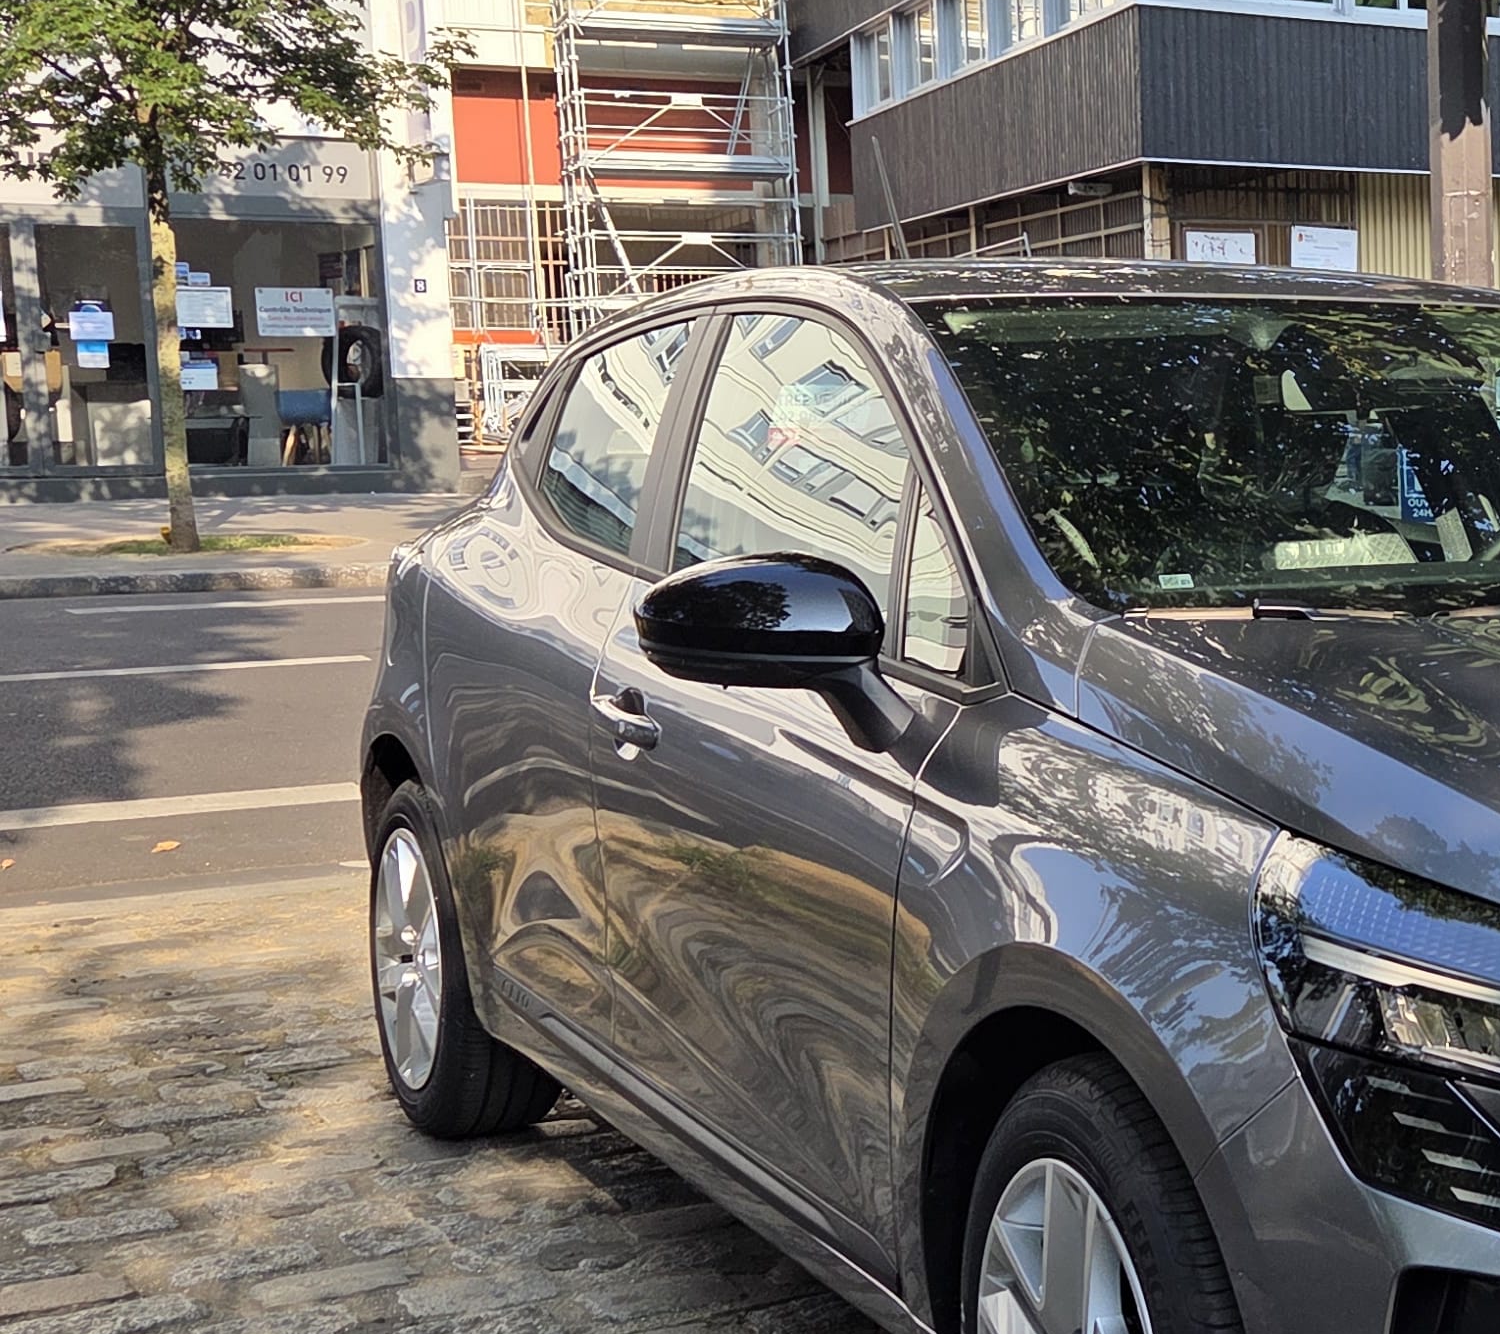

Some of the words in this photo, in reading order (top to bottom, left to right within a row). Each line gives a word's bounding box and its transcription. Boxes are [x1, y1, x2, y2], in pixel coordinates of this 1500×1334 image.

[254, 162, 278, 181] 01
[288, 164, 313, 182] 01
[322, 165, 348, 184] 99
[416, 280, 425, 292] 8
[285, 291, 303, 303] ICI
